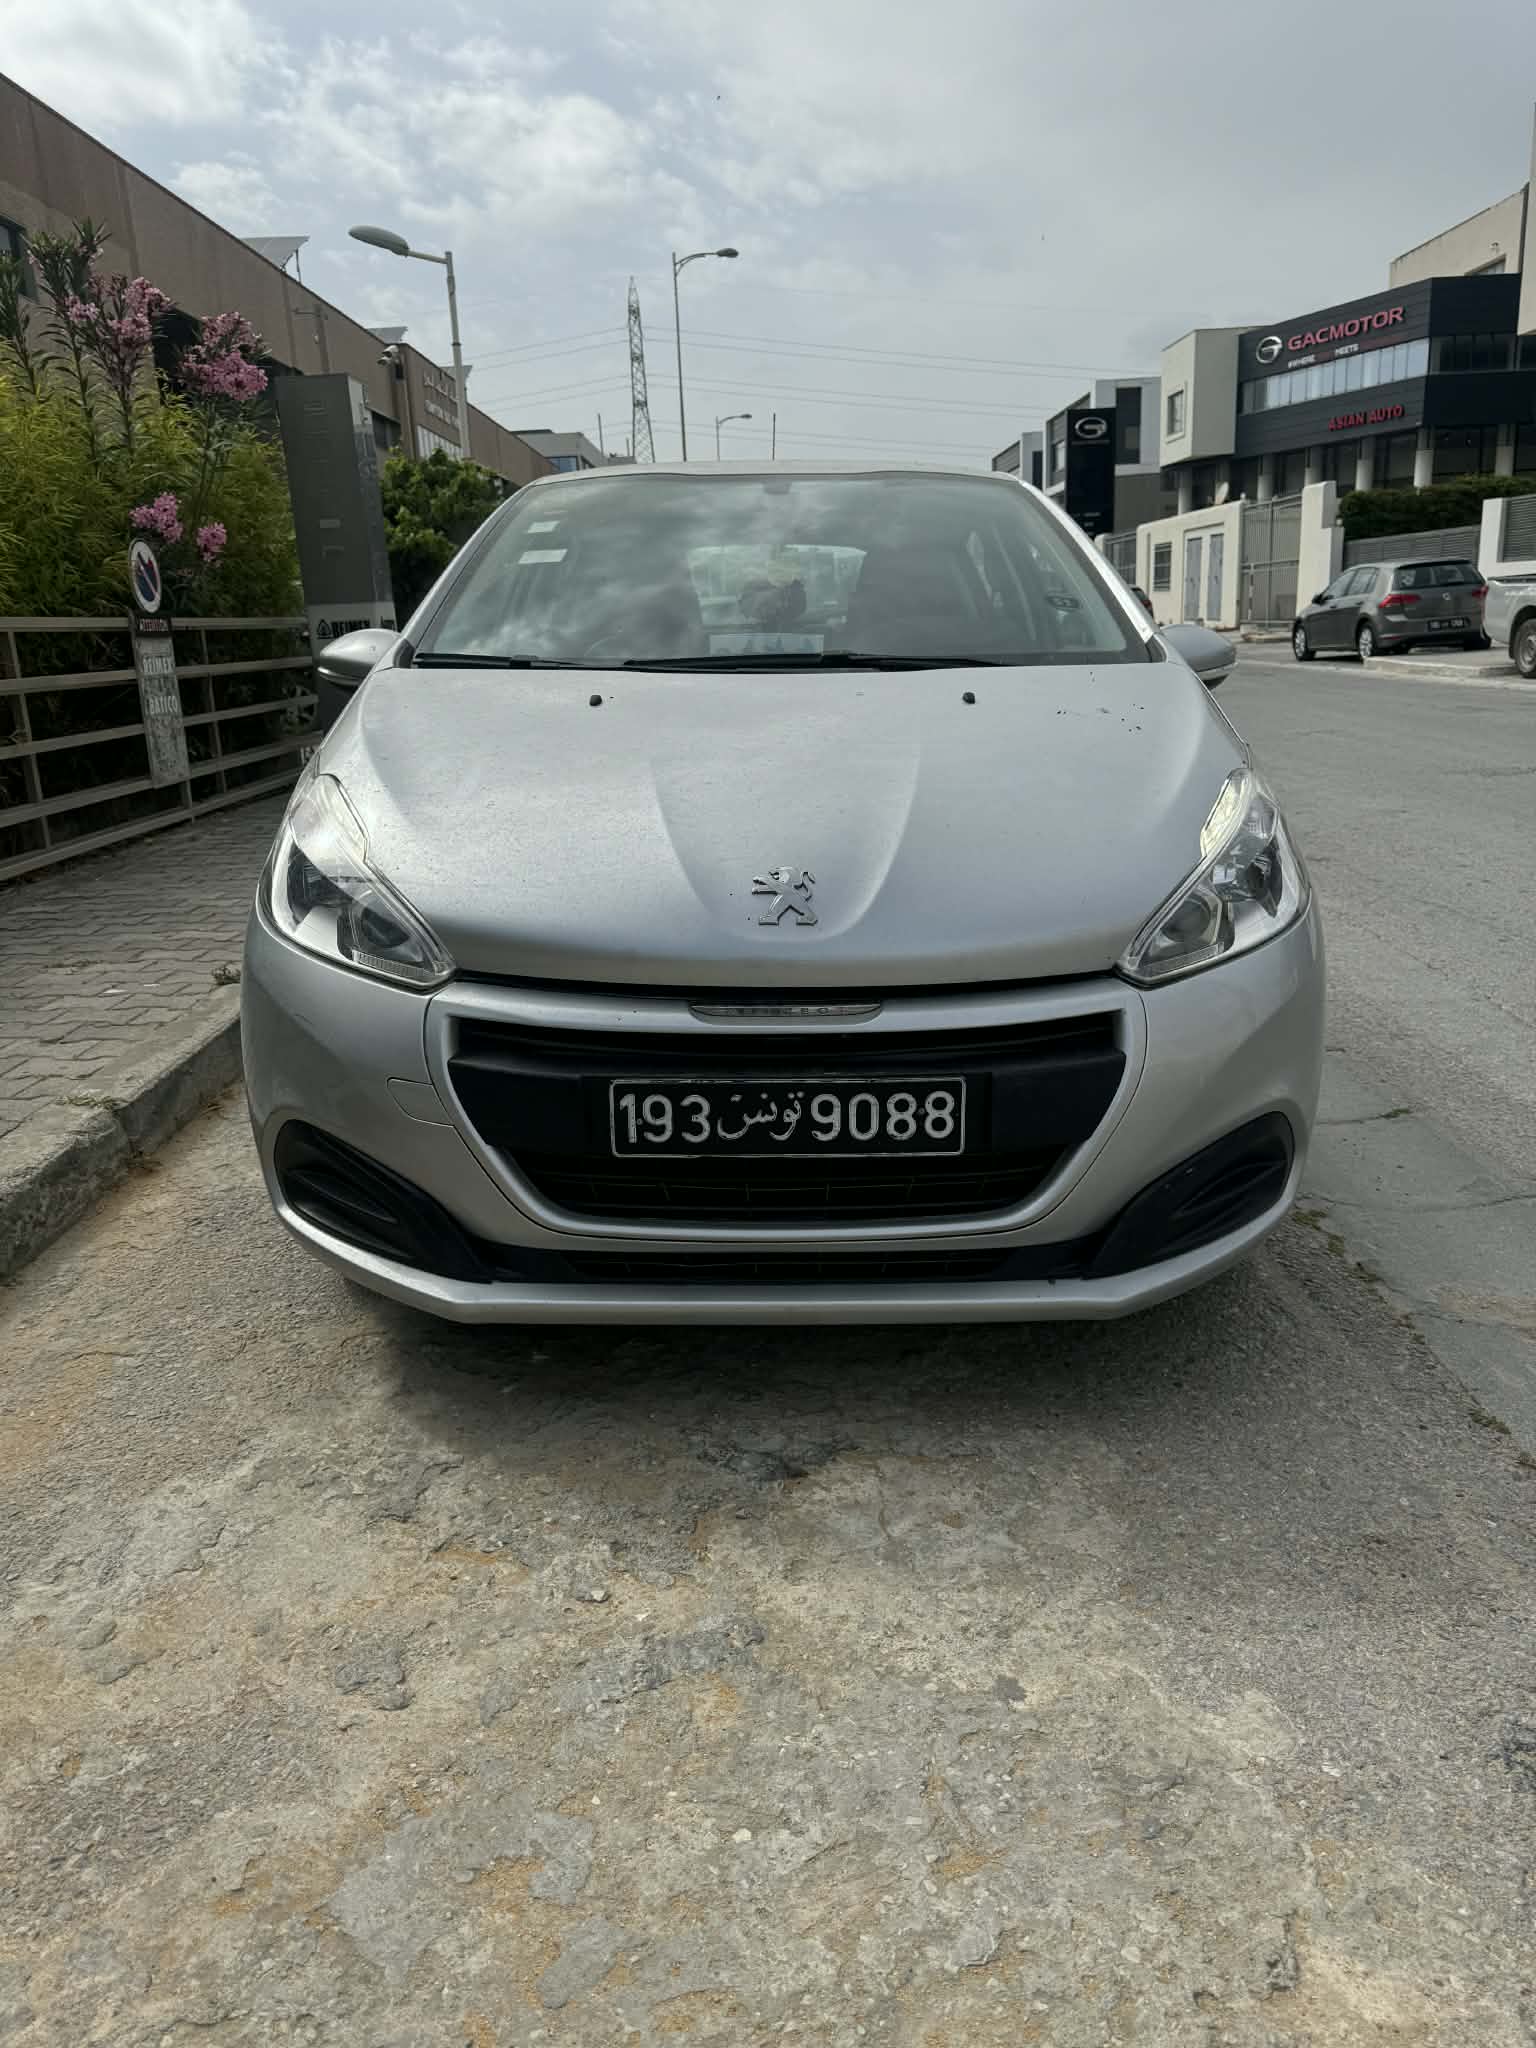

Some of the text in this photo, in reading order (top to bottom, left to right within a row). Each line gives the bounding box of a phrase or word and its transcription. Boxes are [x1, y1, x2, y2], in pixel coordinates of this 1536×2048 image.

[1287, 306, 1403, 350] GACMOTOR
[1328, 404, 1403, 431] ASIAN AUTO
[619, 1093, 711, 1144] 193
[717, 1090, 805, 1140] تونس
[810, 1090, 956, 1142] 9088
